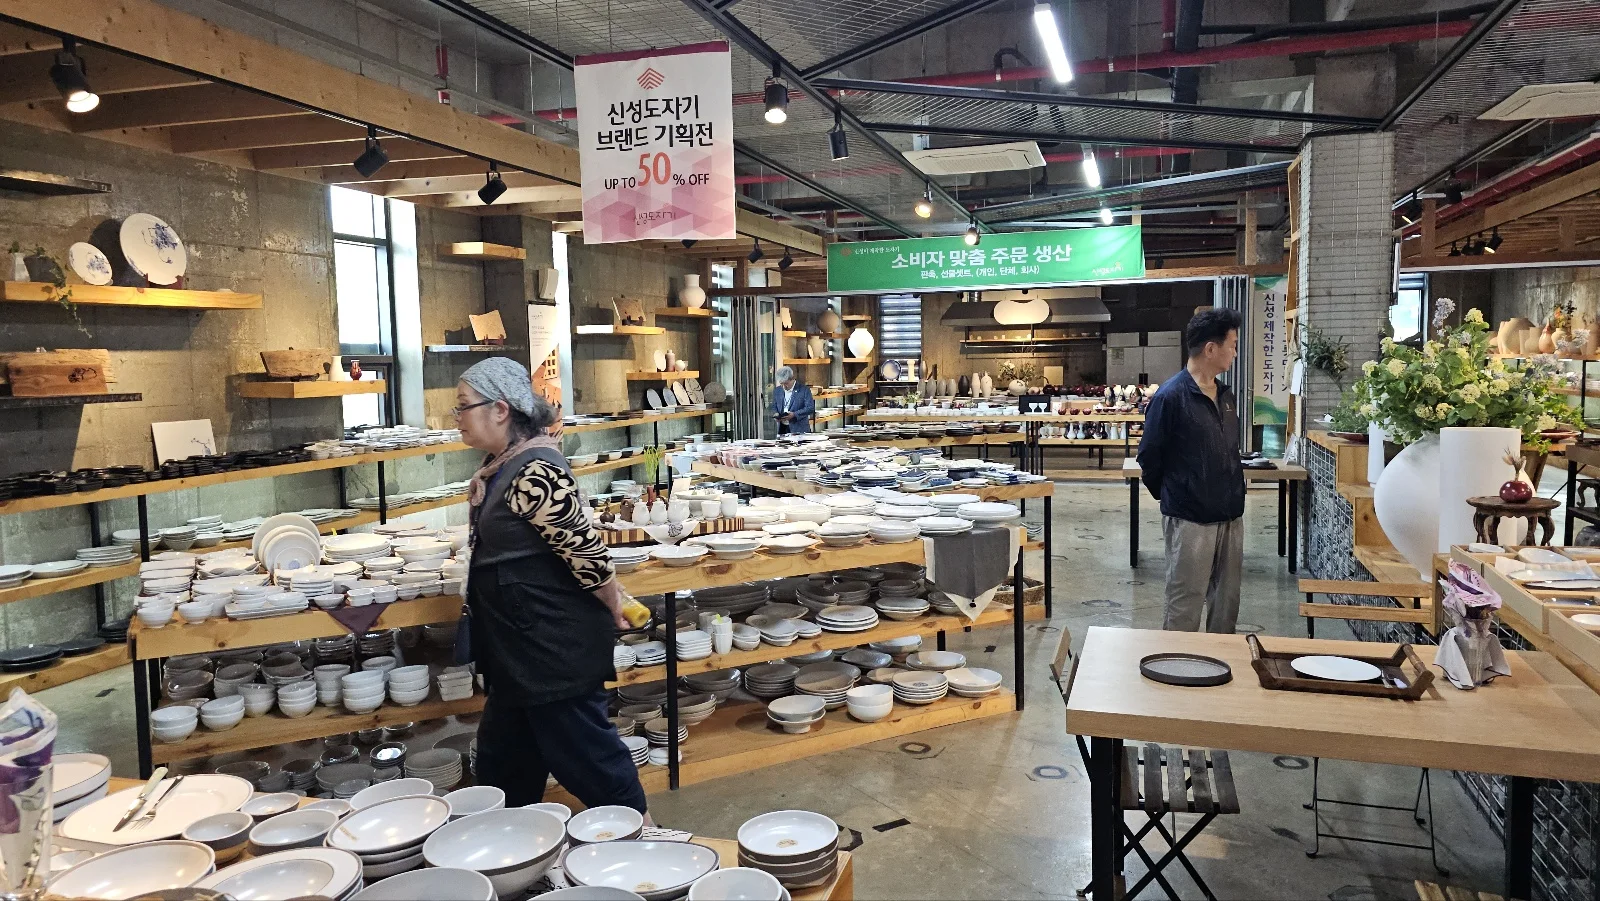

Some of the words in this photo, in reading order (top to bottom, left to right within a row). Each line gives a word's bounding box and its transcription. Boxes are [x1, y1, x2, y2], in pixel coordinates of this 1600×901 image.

[607, 95, 699, 125] 신성도자기
[596, 126, 649, 152] 브랜드
[654, 122, 714, 148] 기획전
[604, 178, 619, 190] UP
[621, 177, 636, 189] TO
[688, 173, 710, 185] OFF
[891, 250, 945, 269] 소비자
[949, 249, 985, 267] 맞춤
[990, 246, 1029, 265] 주문
[1032, 243, 1073, 263] 생산
[1021, 265, 1040, 275] 회사)
